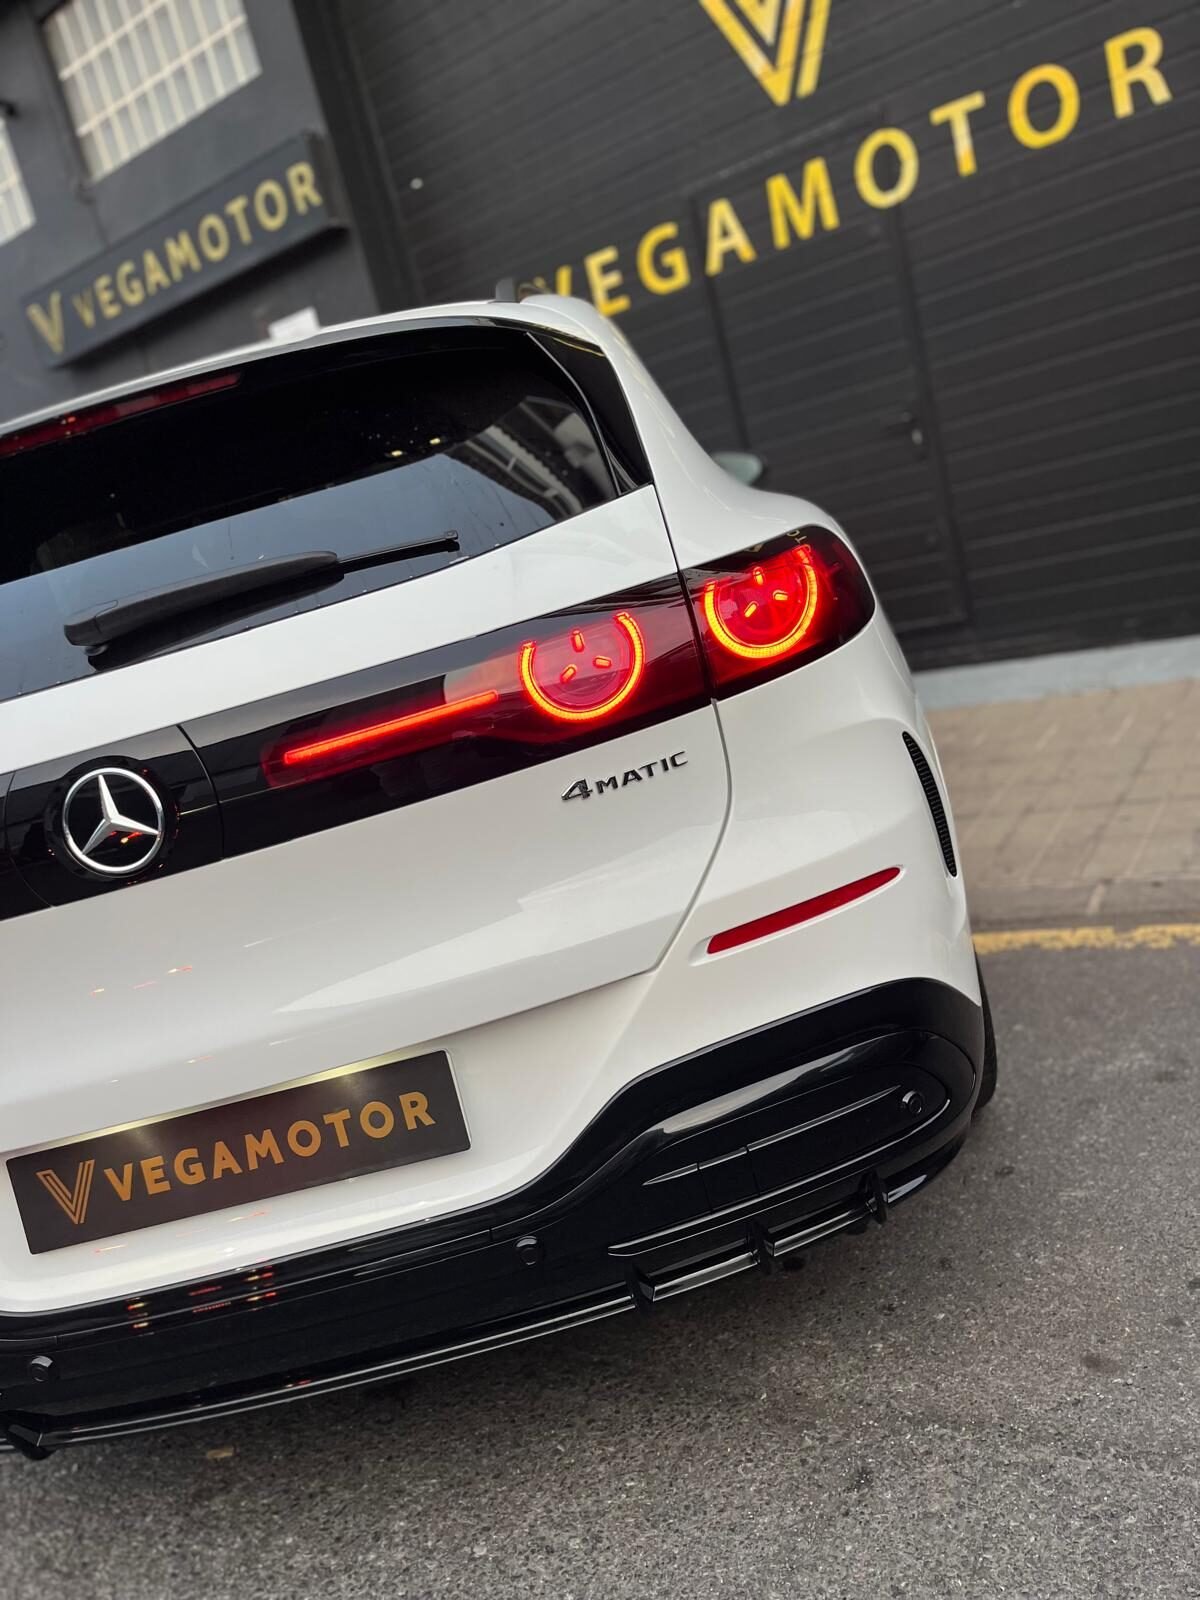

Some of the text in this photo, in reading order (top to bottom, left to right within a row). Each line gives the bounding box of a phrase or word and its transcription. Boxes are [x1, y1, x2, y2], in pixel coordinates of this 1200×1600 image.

[73, 161, 323, 328] VEGAMOTOR
[561, 751, 688, 801] 4MATIC
[104, 1091, 436, 1201] VEGAMOTOR
